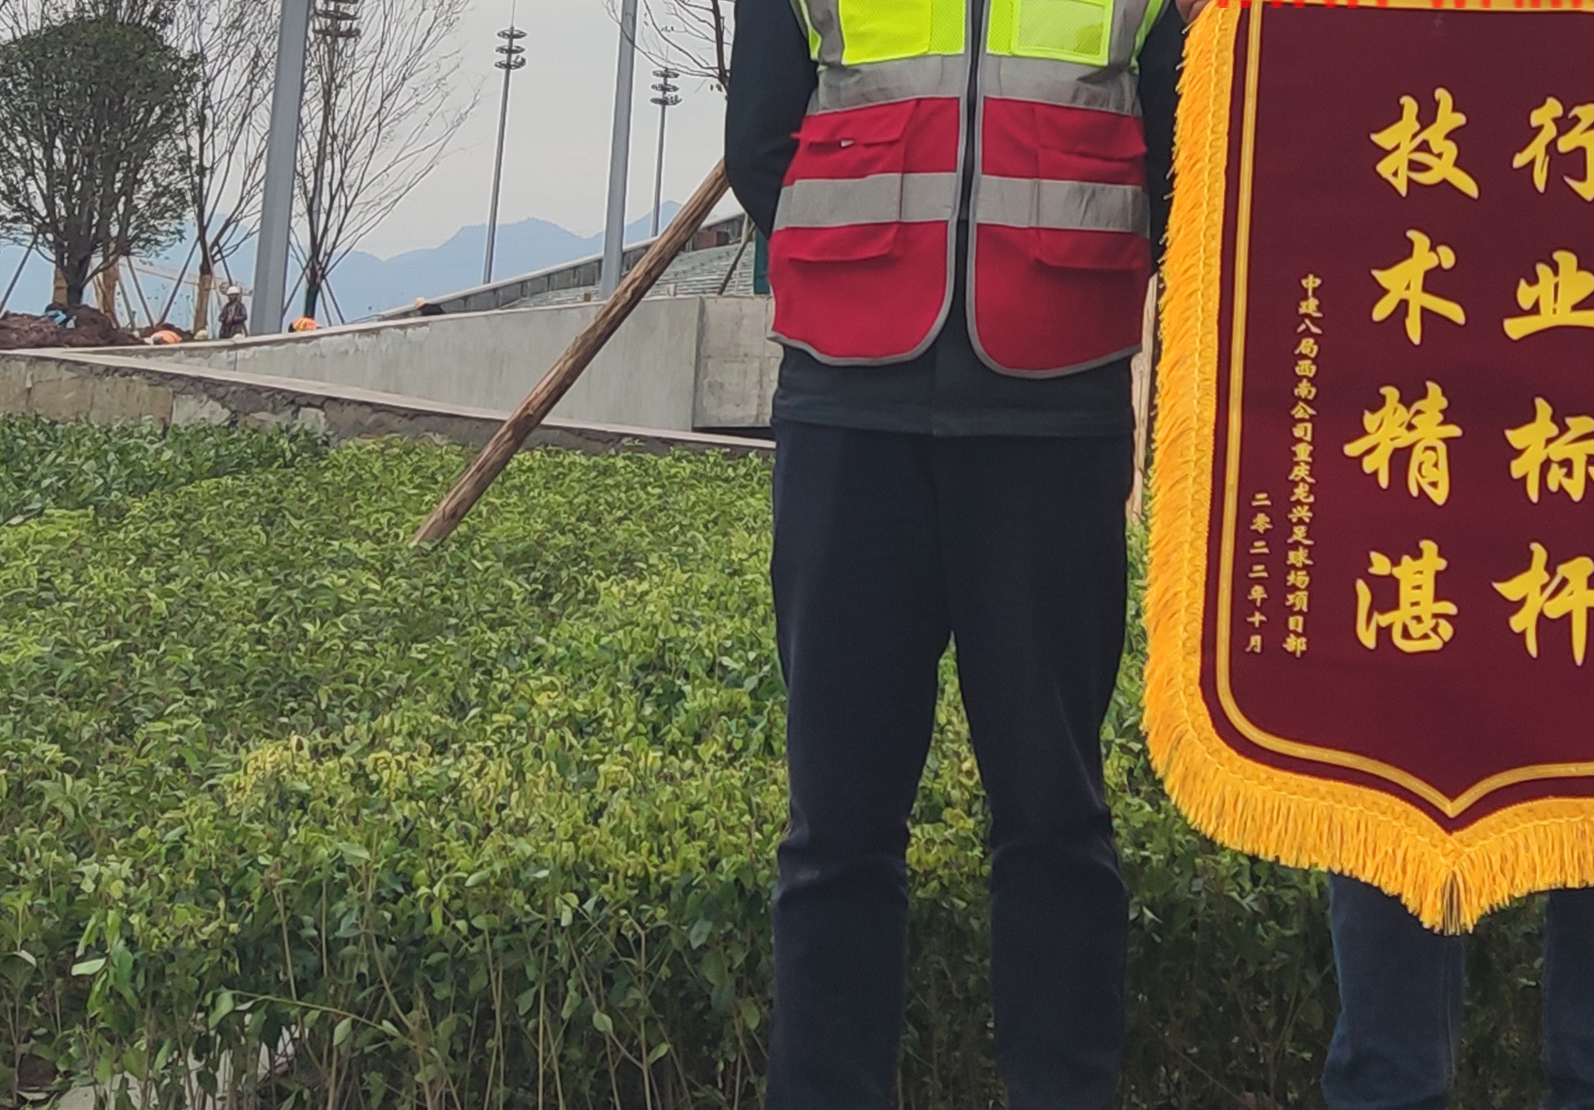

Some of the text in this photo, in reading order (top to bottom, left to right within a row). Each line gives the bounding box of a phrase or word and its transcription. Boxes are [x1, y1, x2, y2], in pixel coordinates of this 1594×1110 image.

[1342, 87, 1479, 654] 技术精湛
[1244, 492, 1274, 654] 二零二二年十月
